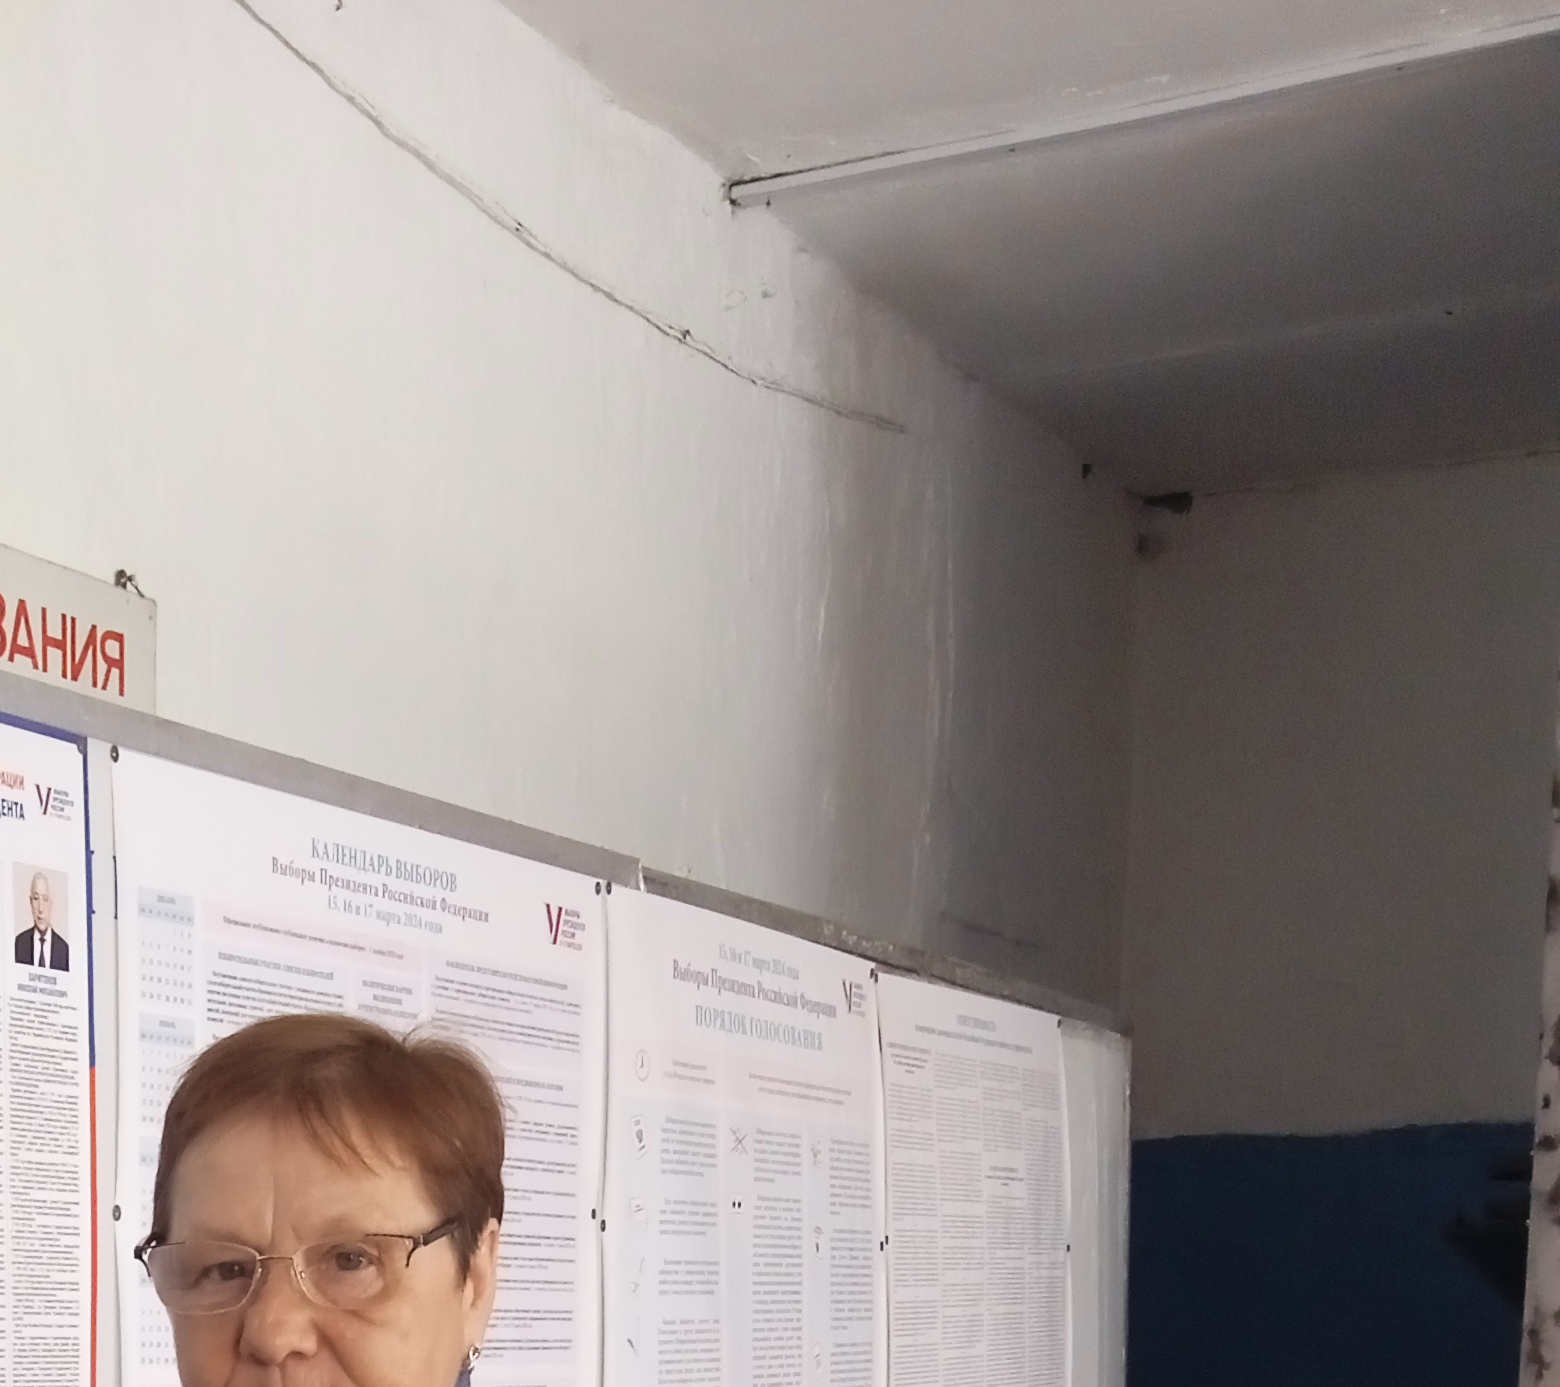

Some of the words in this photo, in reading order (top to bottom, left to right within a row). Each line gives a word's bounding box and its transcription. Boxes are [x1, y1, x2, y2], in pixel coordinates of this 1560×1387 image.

[271, 856, 316, 885] Выборы
[319, 868, 379, 898] Президента
[381, 884, 438, 911] Российской
[439, 896, 490, 924] Федерации
[310, 837, 393, 878] КАЛЕНДАРЬ
[395, 858, 458, 894] ВЫБОРОВ
[342, 898, 354, 916] 16
[362, 901, 374, 919] 17
[375, 907, 402, 930] марта
[403, 910, 423, 930] 2024
[423, 918, 444, 935] года
[672, 958, 709, 990] Выборы
[710, 967, 756, 999] Президента
[756, 979, 799, 1010] Российской
[694, 1003, 748, 1036] ПОРЯДОК
[749, 1015, 824, 1052] ГОЛОСОВАНИЯ
